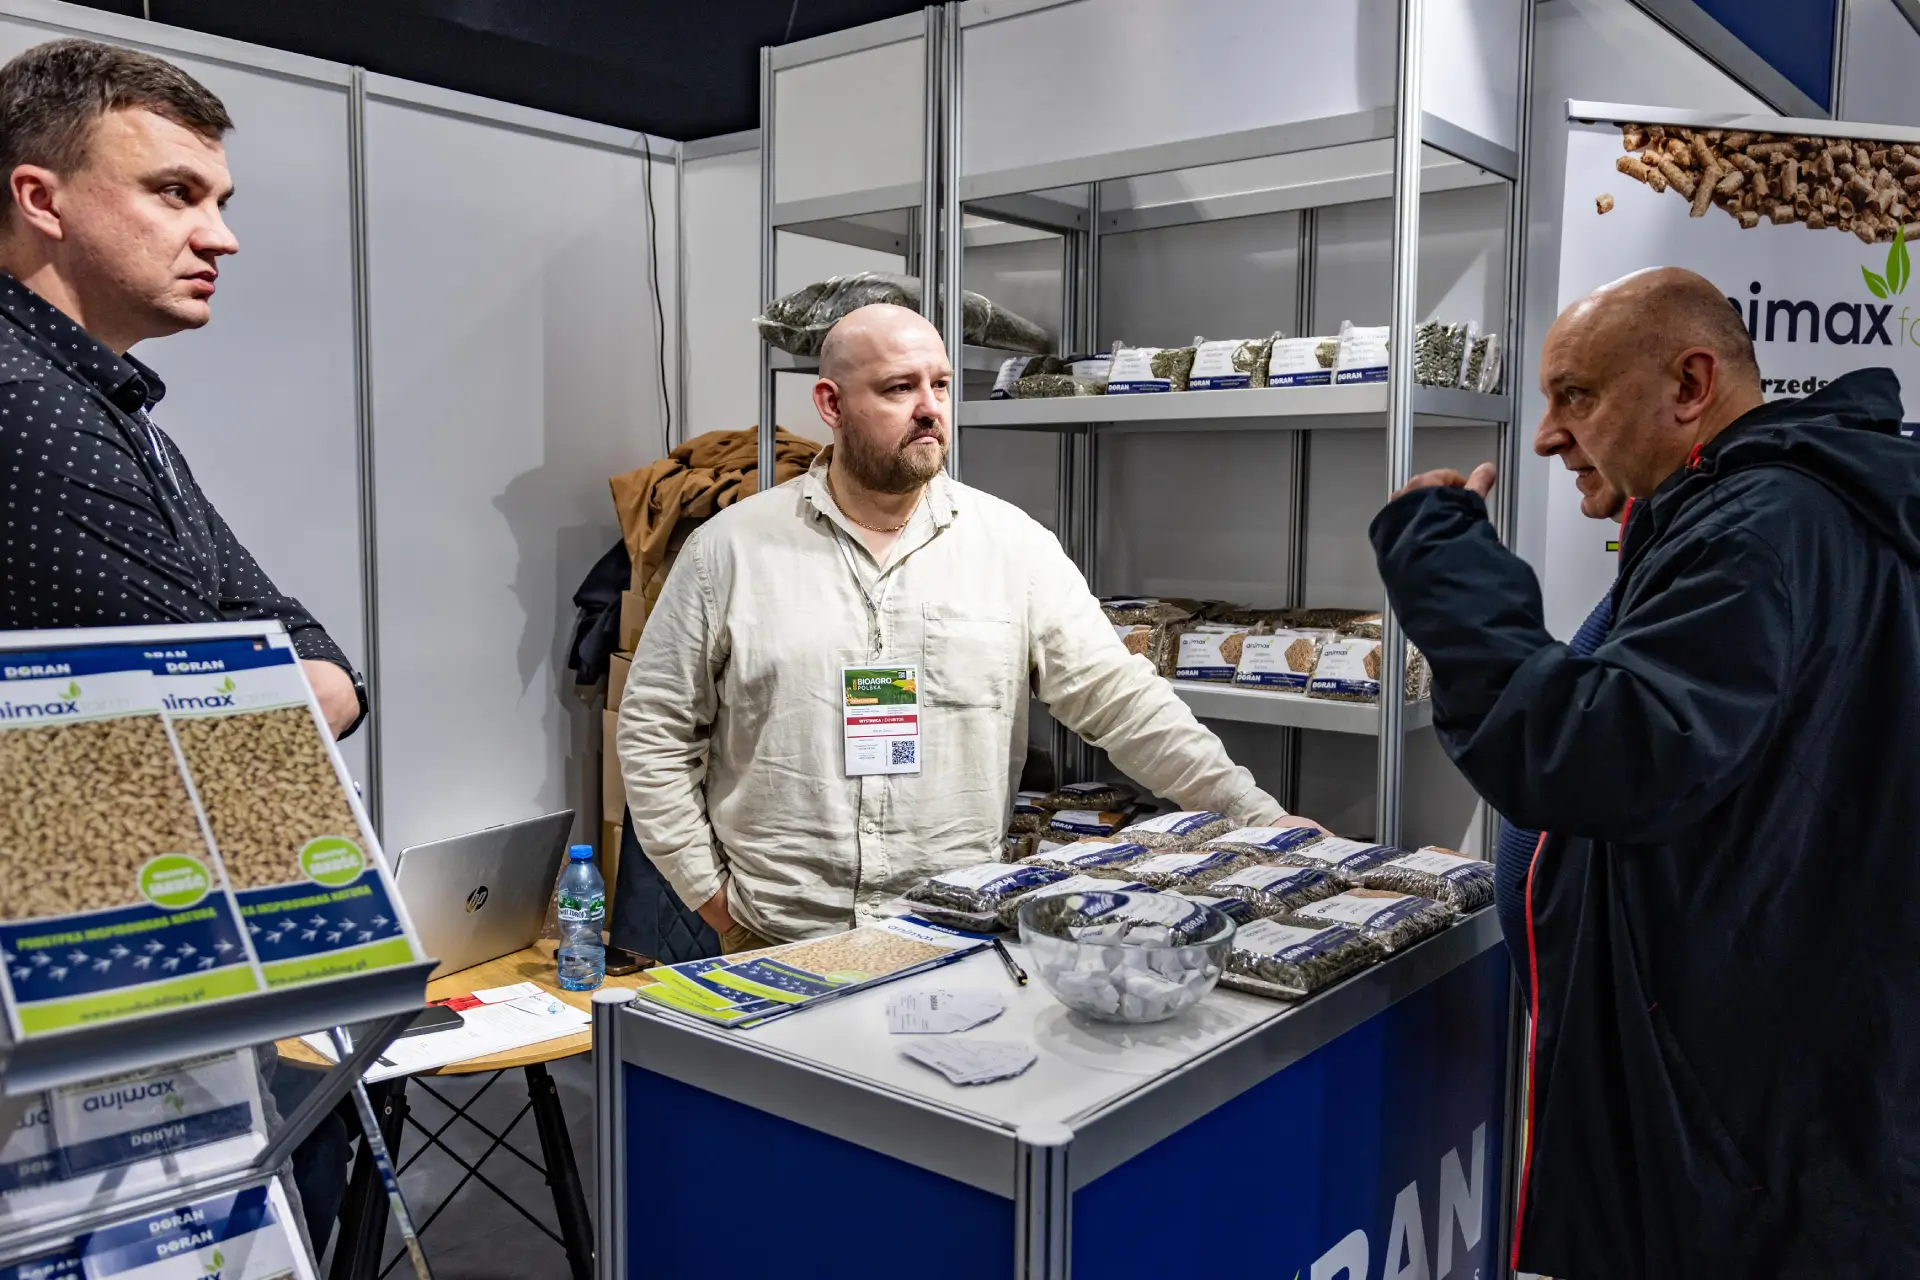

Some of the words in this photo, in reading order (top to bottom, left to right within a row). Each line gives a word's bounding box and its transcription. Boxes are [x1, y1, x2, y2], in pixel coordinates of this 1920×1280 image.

[1728, 281, 1894, 346] imax
[1189, 379, 1211, 387] DORAN
[1270, 377, 1294, 385] DORAN
[1337, 372, 1363, 381] DORAN
[1324, 649, 1349, 657] animax
[4, 663, 71, 679] DORAN
[165, 659, 225, 673] DORAN
[857, 677, 892, 685] BIOAGRO
[1236, 674, 1261, 682] DORAN
[1051, 821, 1074, 830] DORAN
[1345, 853, 1371, 867] DORAN
[984, 876, 1017, 892] DORAN
[1268, 880, 1294, 894] DORAN
[468, 887, 488, 915] hp
[1370, 911, 1396, 928] DORAN
[888, 925, 934, 941] animax
[928, 924, 960, 935] DORAN
[149, 1209, 205, 1234] DORAN
[156, 1229, 214, 1258] DORAN
